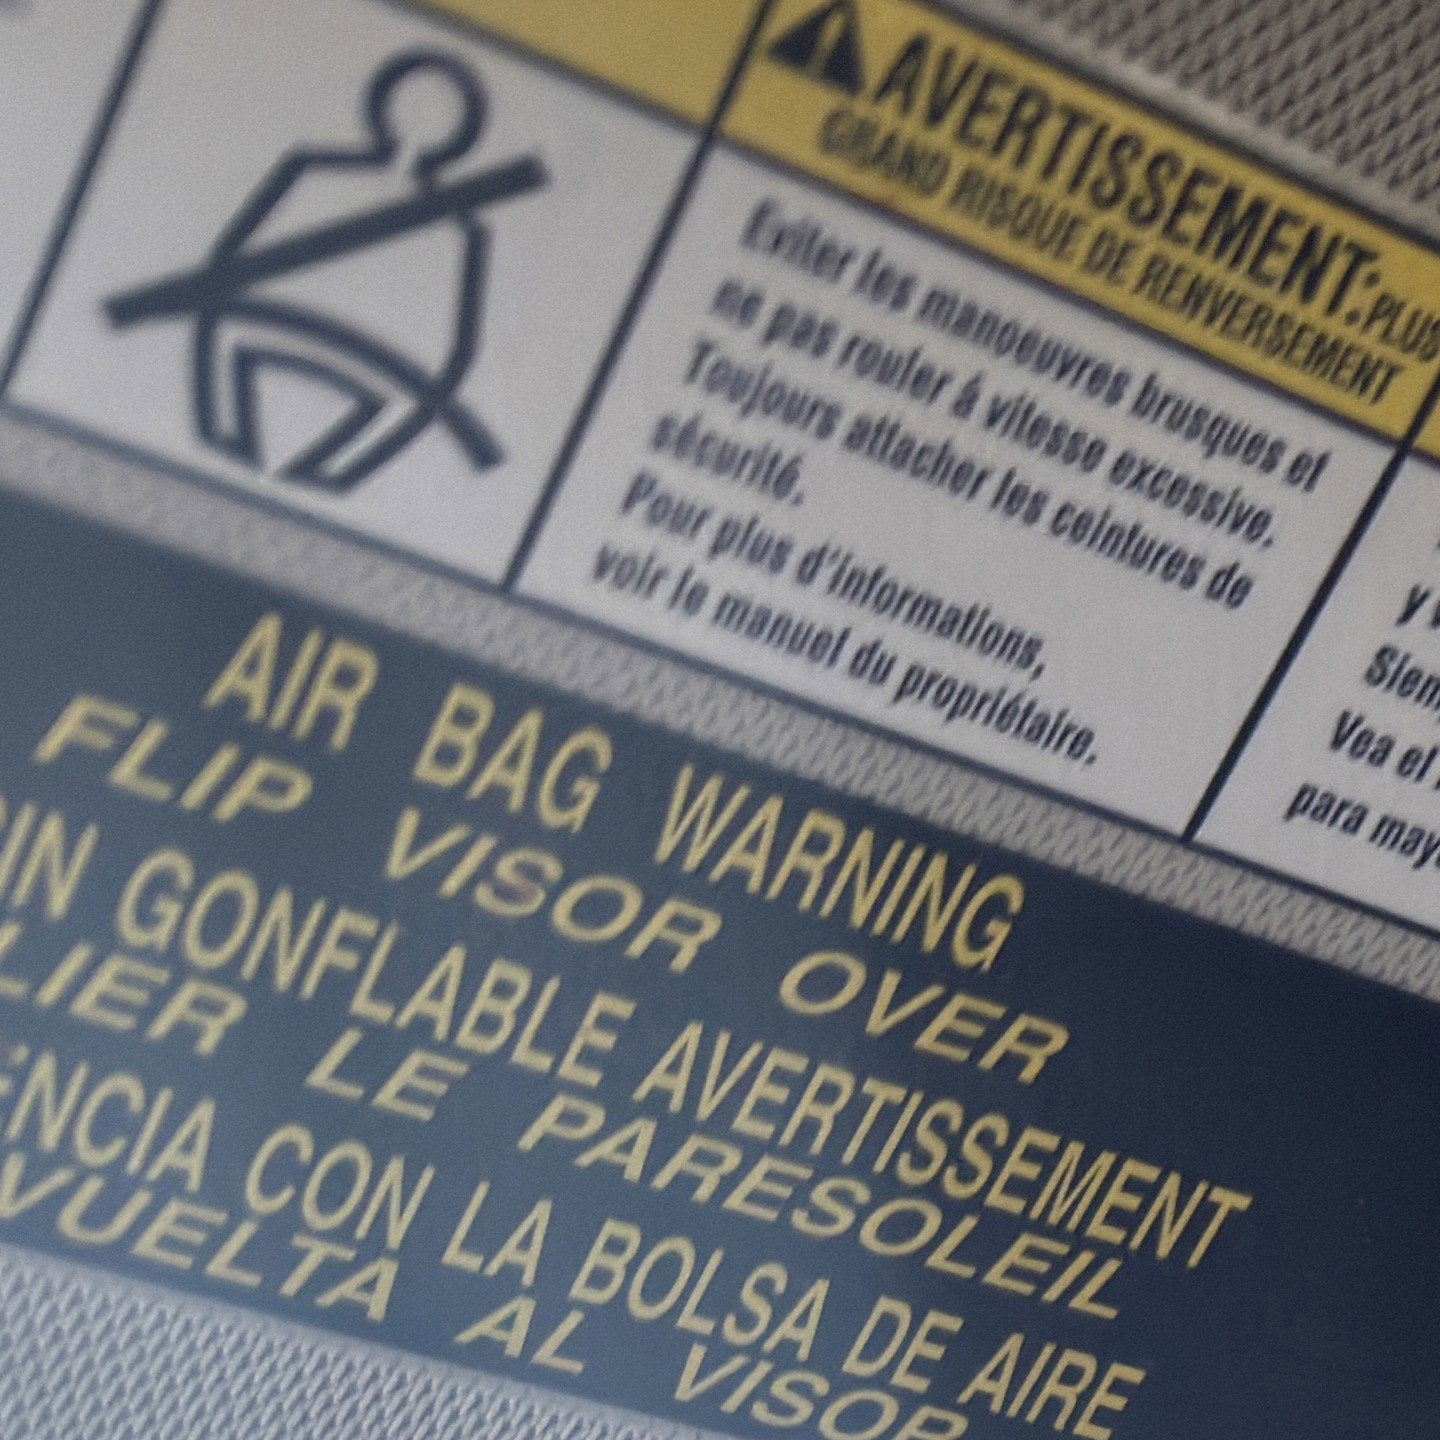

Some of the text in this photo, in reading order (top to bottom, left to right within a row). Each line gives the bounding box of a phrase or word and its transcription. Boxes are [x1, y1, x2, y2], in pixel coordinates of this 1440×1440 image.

[871, 33, 1380, 325] AVERTISSEMENT:
[947, 165, 1087, 260] RISQUE
[1081, 226, 1139, 285] DE
[1132, 253, 1402, 403] RENVERSEMENT
[1329, 709, 1395, 767] Vea
[1395, 745, 1440, 782] el
[1396, 585, 1430, 626] y
[36, 695, 1068, 1083] FLIP VISOR OVER
[205, 614, 1024, 969] AIR BAG WARNING
[1283, 783, 1369, 835] para
[116, 848, 635, 1087] GONFLABLE
[630, 1020, 1252, 1267] AVERTISSEMENT
[305, 1028, 468, 1121] LE
[516, 1091, 1120, 1318] PARESOLEIL
[0, 1045, 215, 1192] NCIA
[243, 1123, 435, 1250] CON
[441, 1181, 552, 1287] LA
[568, 1218, 829, 1361] BOLSA
[840, 1295, 963, 1393] DE
[0, 1152, 398, 1320] VUELTA
[455, 1295, 584, 1373] AL
